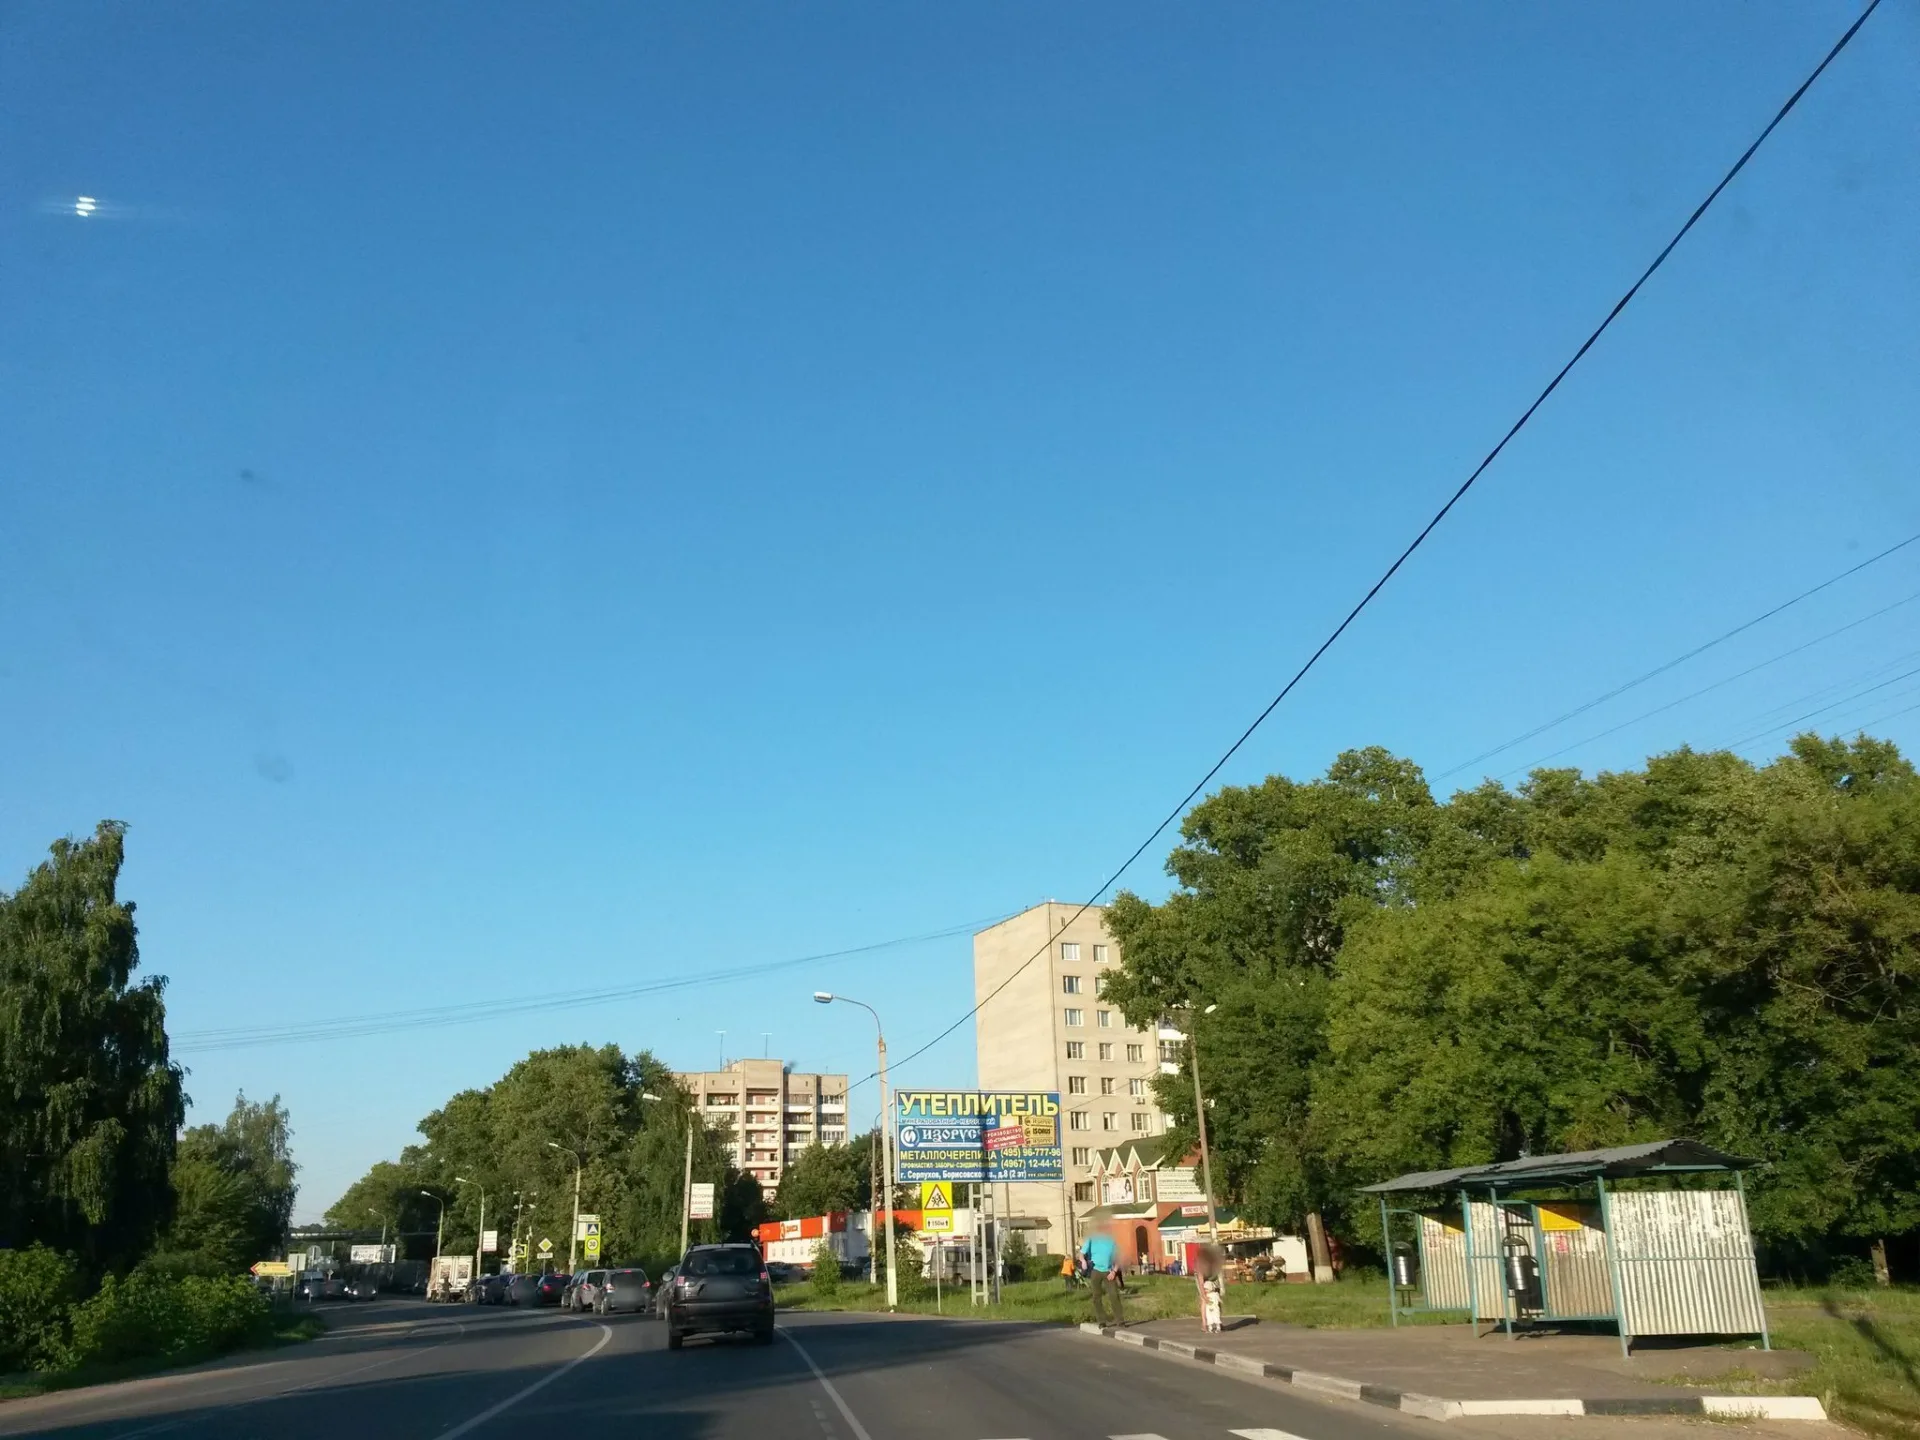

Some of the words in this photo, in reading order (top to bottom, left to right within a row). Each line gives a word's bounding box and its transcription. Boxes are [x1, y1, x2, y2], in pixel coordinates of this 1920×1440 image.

[899, 1093, 1059, 1117] УТЕПЛИТЕЛЬ
[900, 1150, 997, 1161] МЕТАЛЛОЧЕРЕПИЦА
[1000, 1148, 1021, 1158] (495)
[1001, 1159, 1026, 1169] (4967)
[1028, 1159, 1062, 1168] 12-44-12
